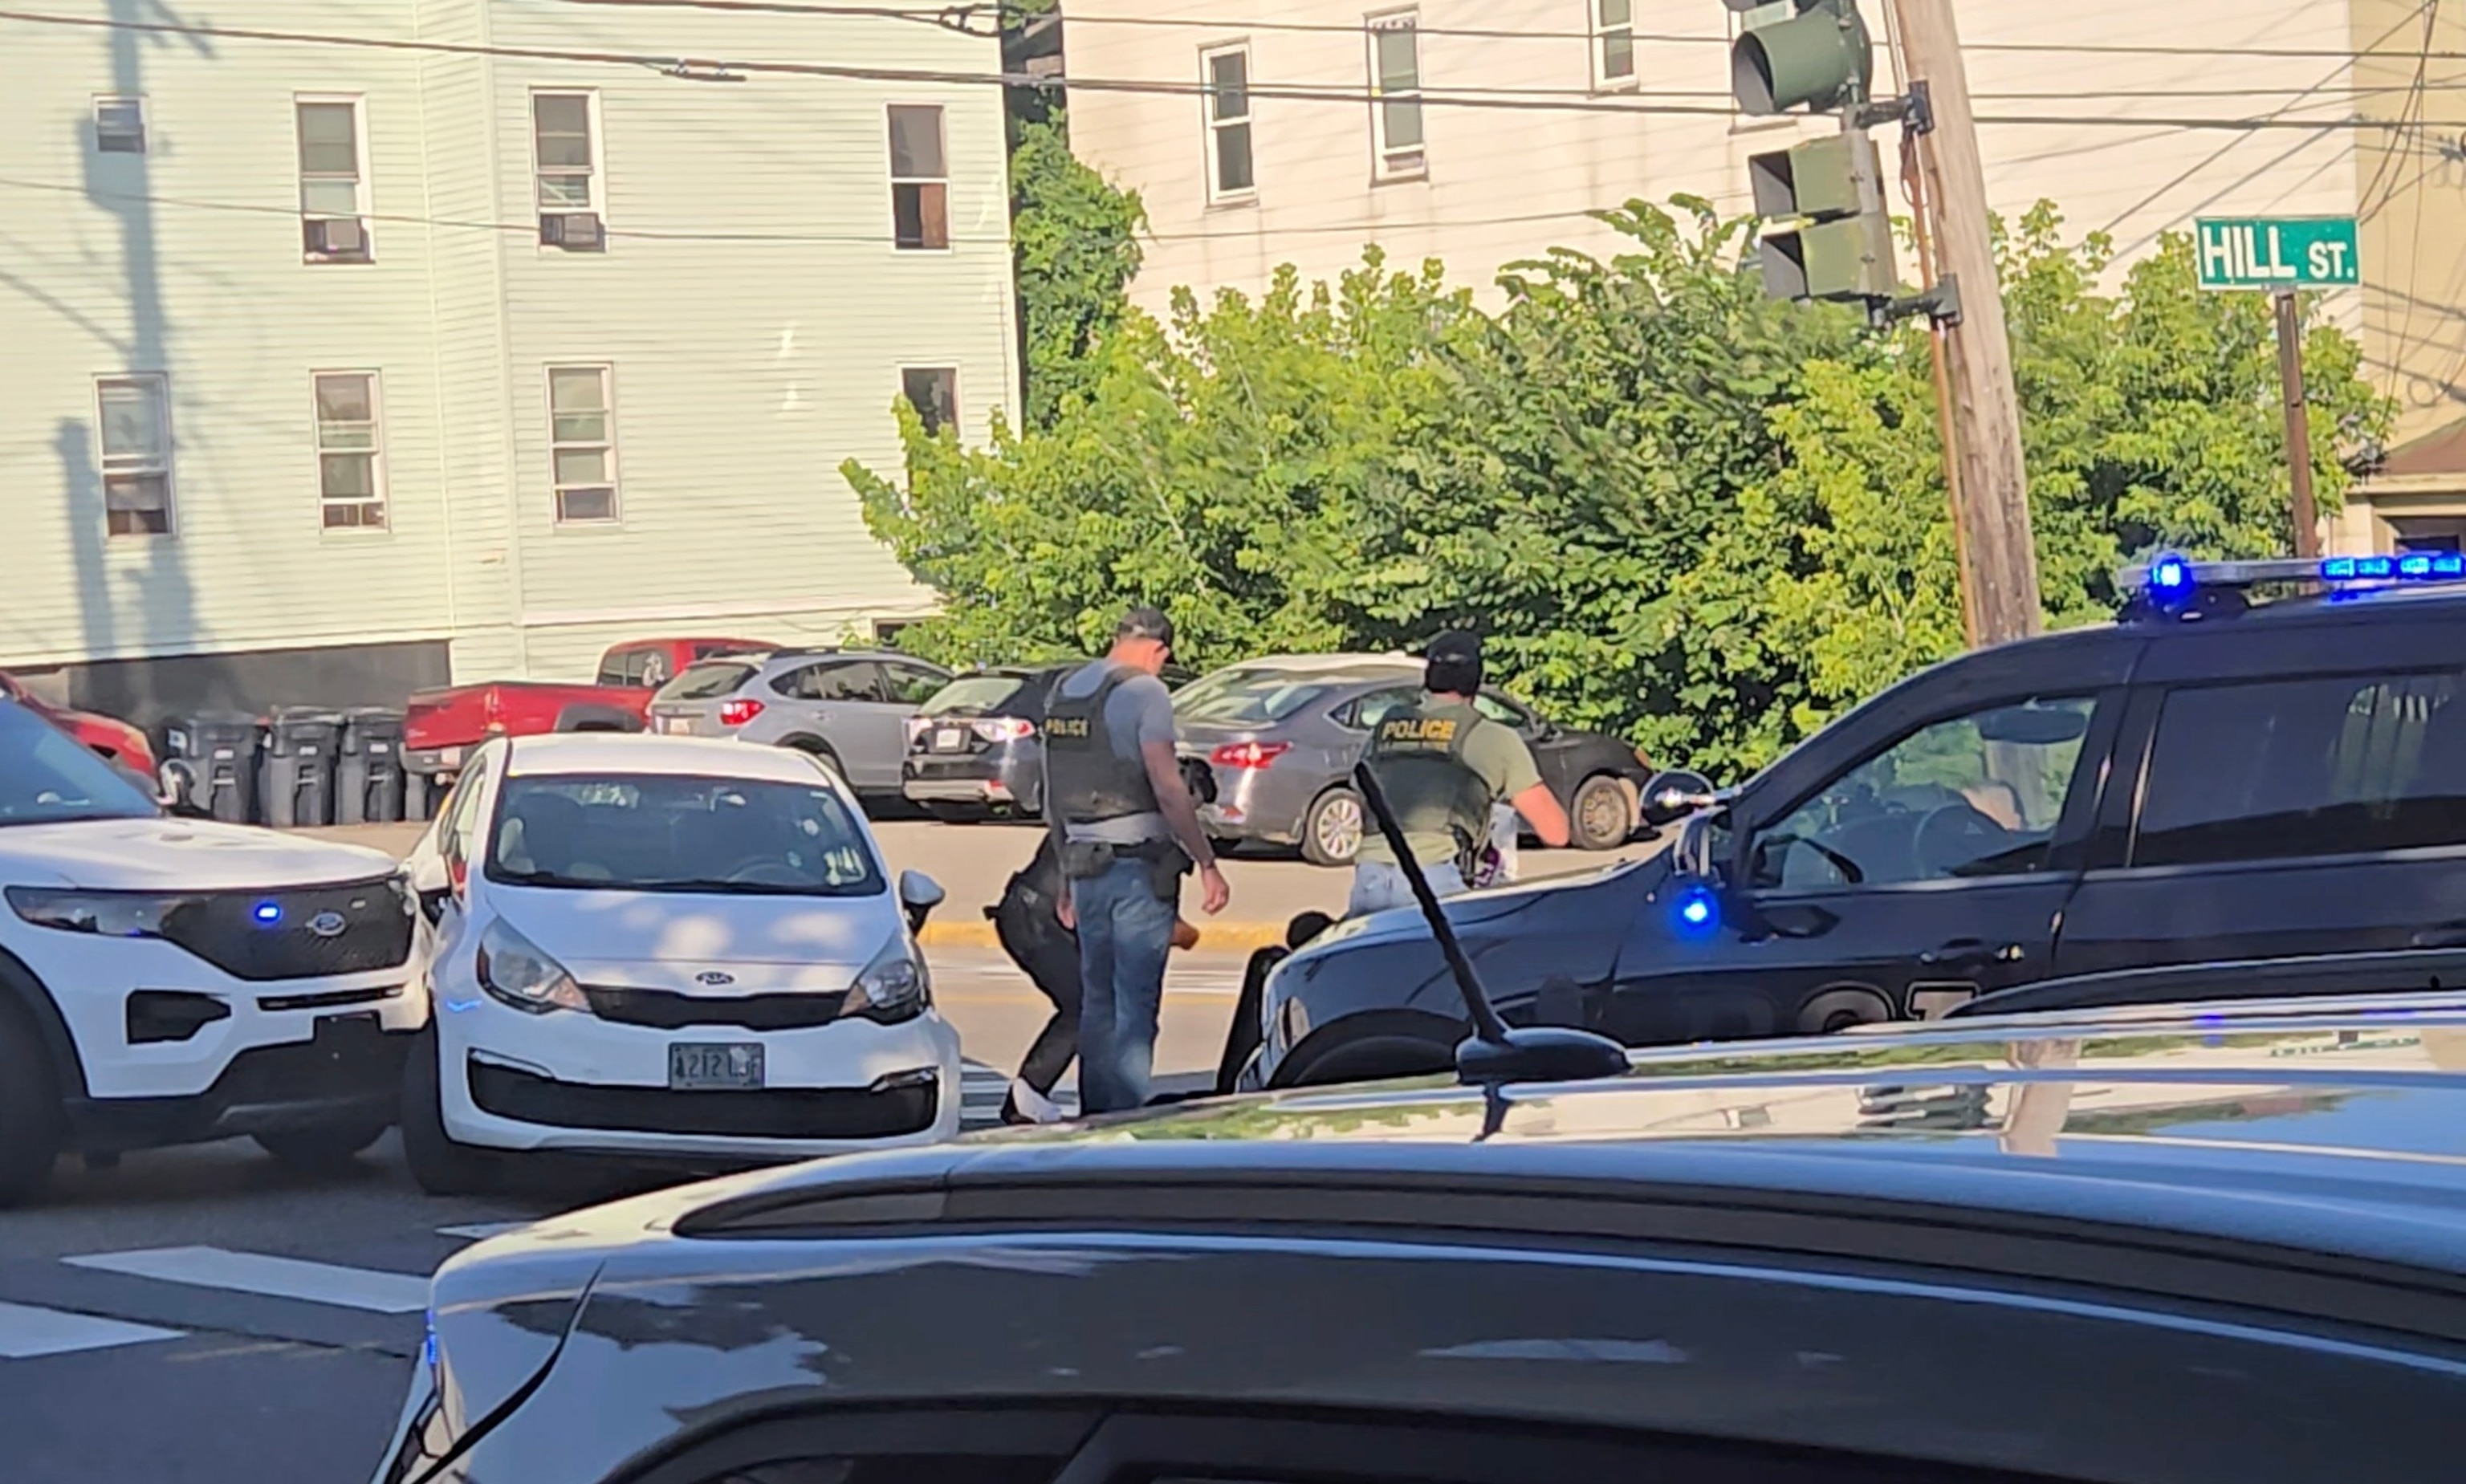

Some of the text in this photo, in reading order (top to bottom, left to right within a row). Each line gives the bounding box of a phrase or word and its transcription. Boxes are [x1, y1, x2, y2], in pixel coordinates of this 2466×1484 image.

[2202, 226, 2354, 279] HILL ST.
[1045, 718, 1089, 736] POLICE
[1381, 718, 1457, 740] POLICE
